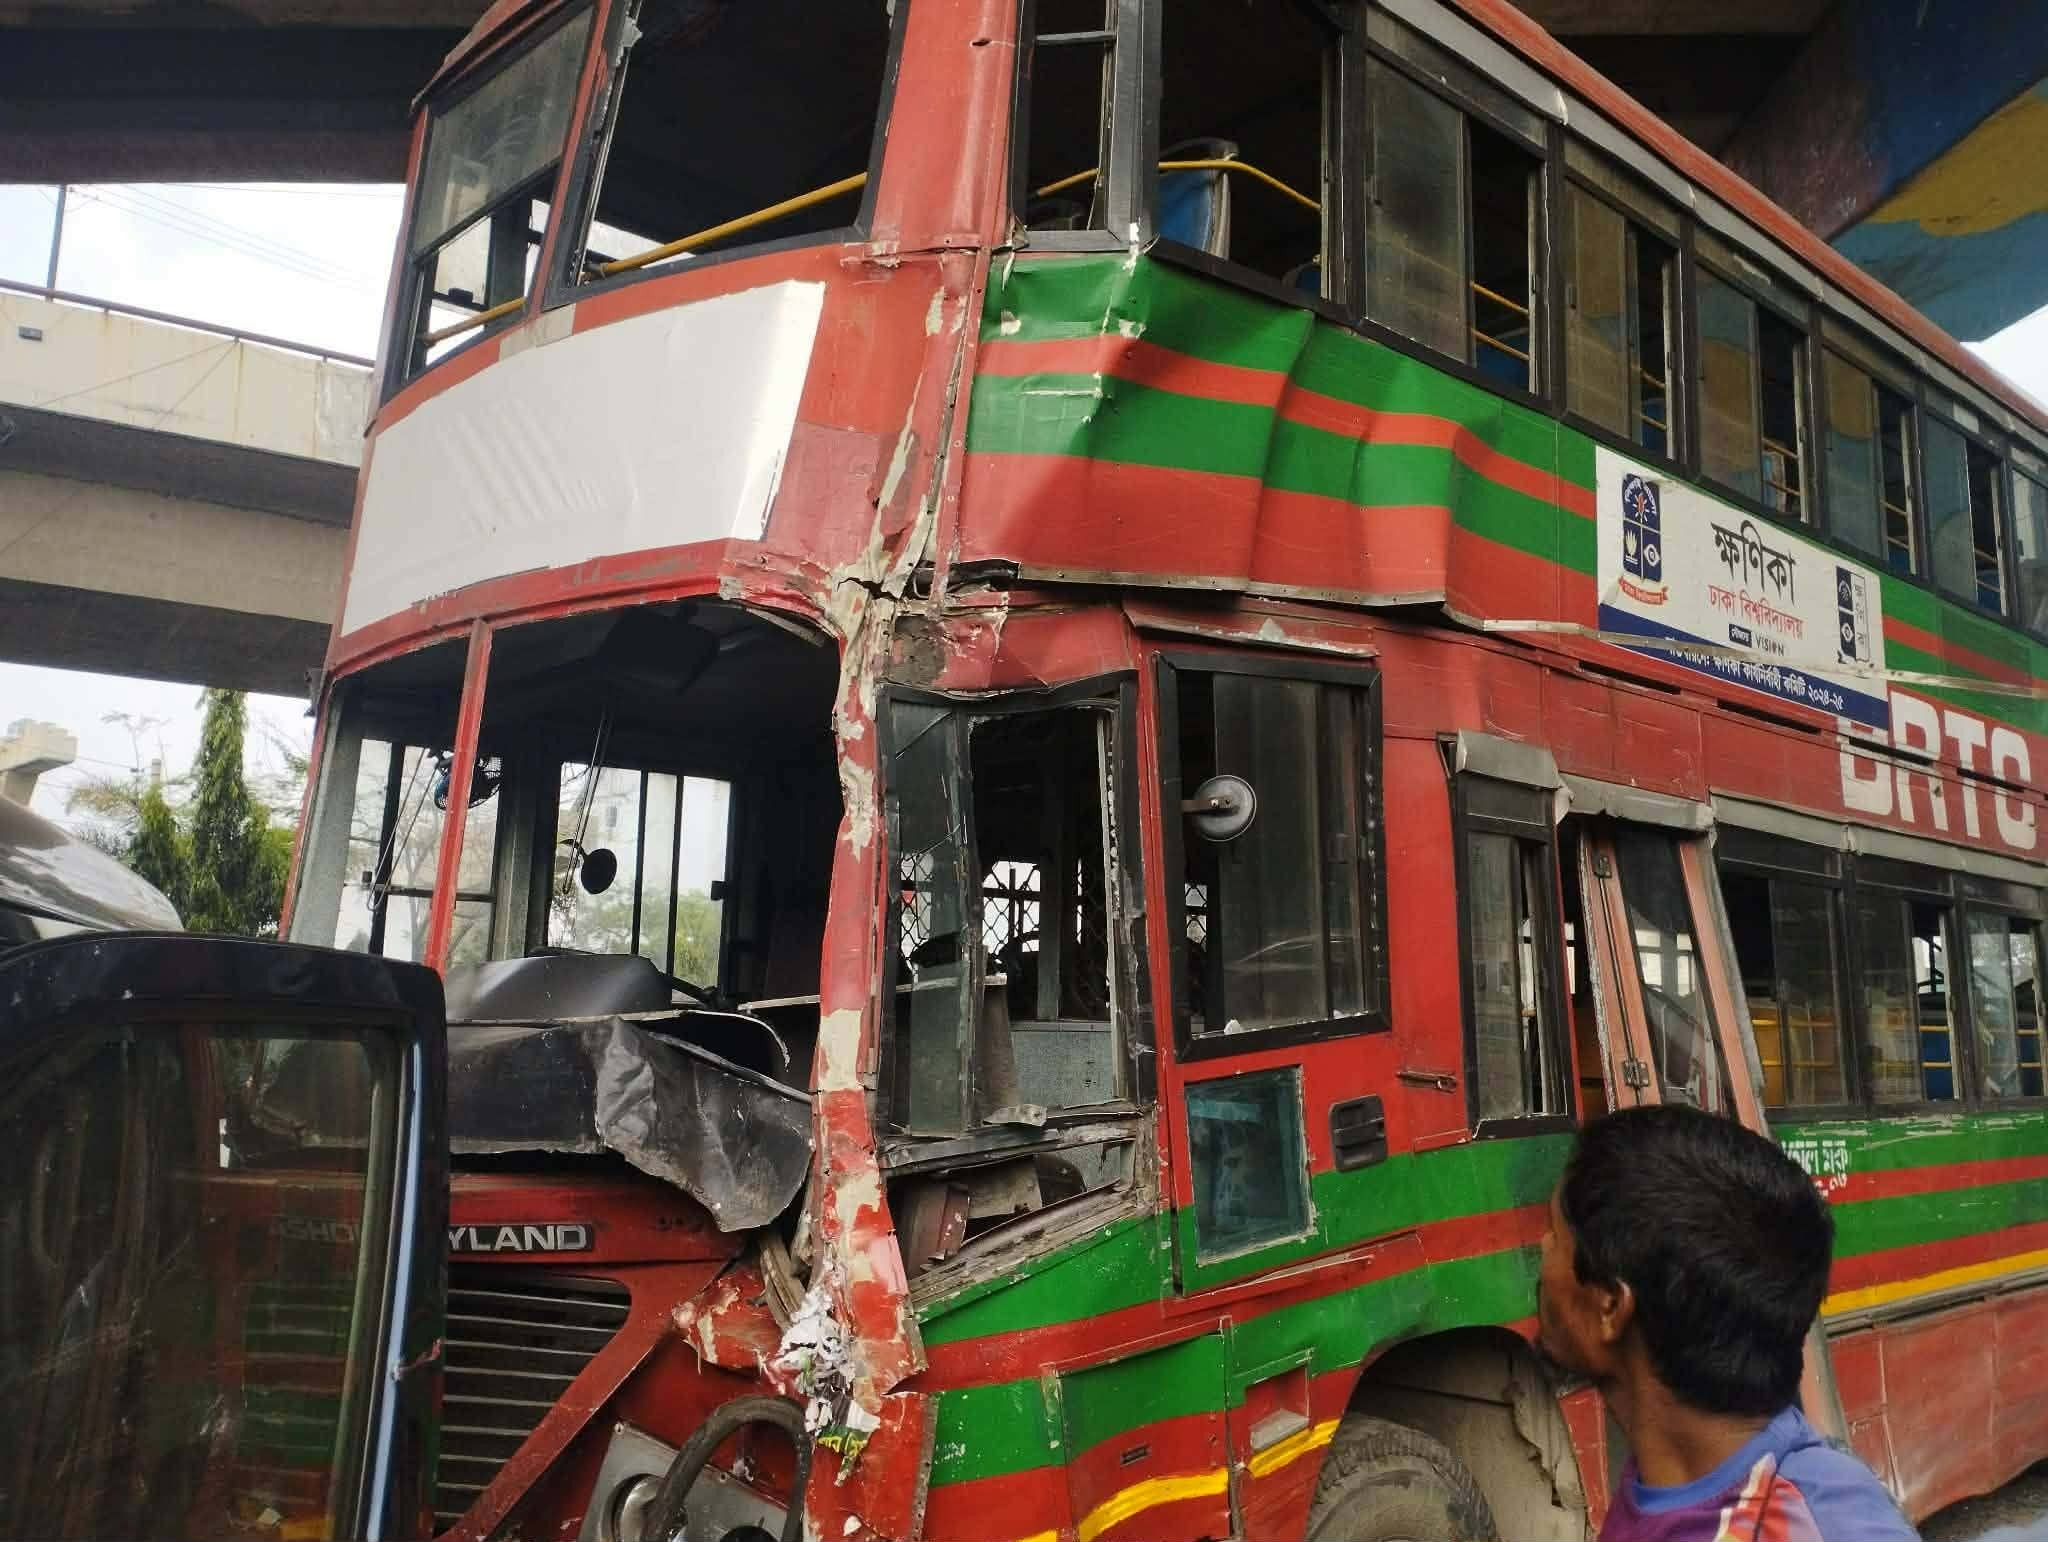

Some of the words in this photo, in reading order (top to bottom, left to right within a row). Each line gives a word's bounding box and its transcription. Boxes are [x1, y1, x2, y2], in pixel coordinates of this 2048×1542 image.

[1711, 520, 1796, 605] ক্ষণিকা
[1708, 584, 1736, 615] ঢাকা
[1836, 691, 2037, 850] BRTC
[448, 1225, 587, 1251] YLAND
